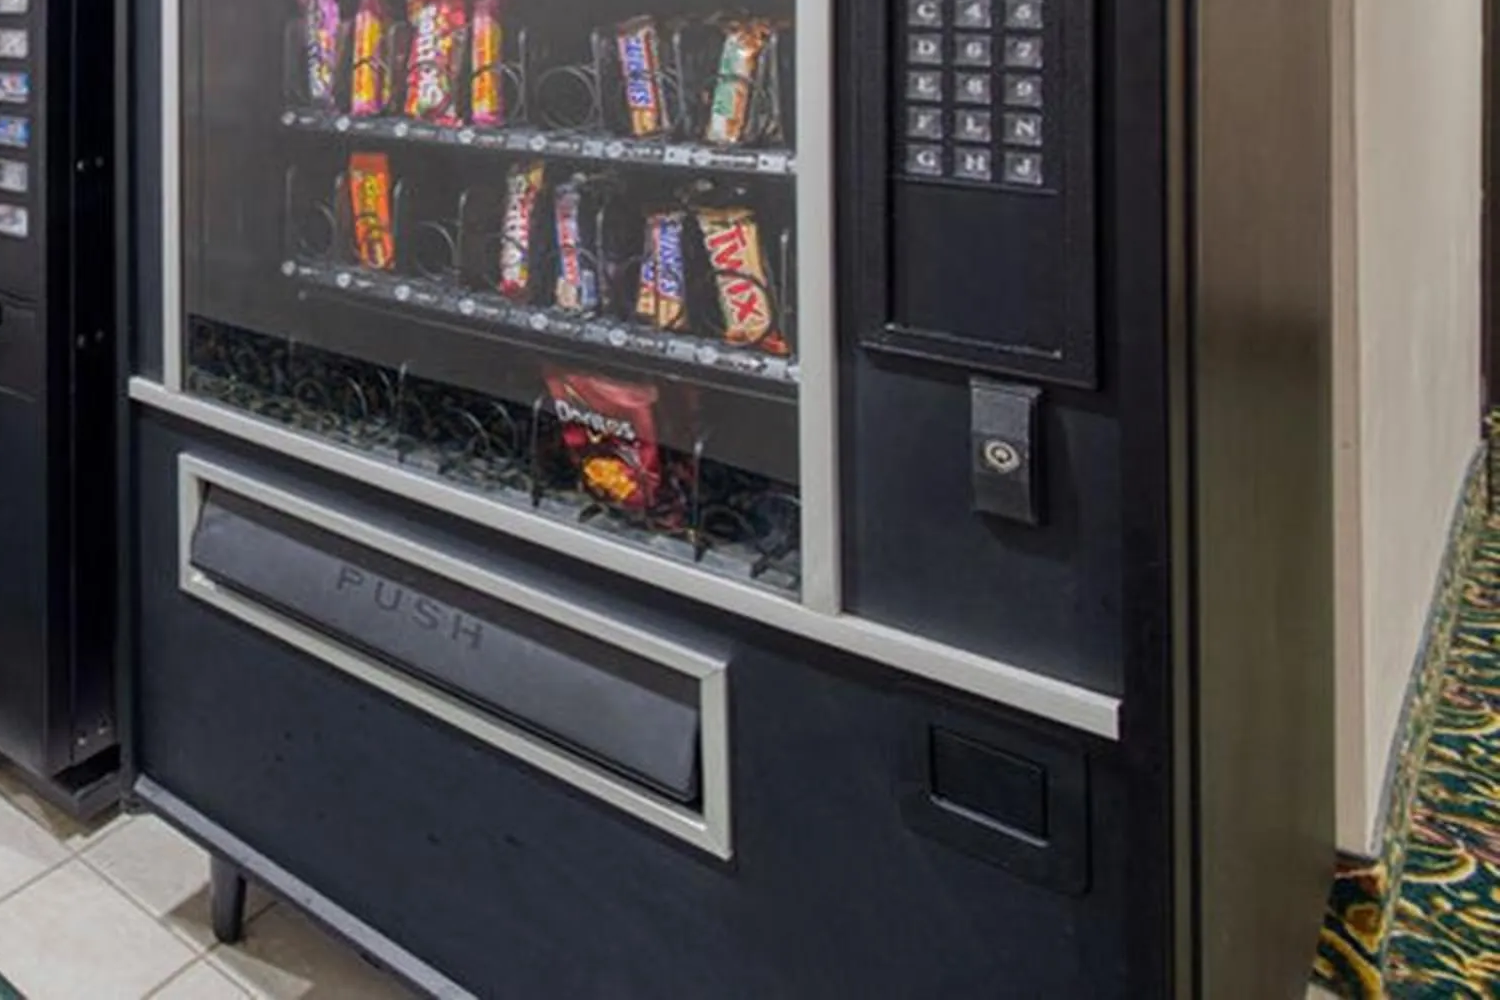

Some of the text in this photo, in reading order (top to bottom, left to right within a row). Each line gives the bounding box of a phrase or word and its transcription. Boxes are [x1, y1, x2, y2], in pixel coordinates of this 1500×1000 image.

[917, 2, 936, 19] C
[964, 2, 981, 19] 4
[918, 40, 936, 55] D
[918, 77, 935, 92] E
[966, 116, 983, 133] L
[916, 150, 935, 167] G
[965, 154, 986, 171] H
[1015, 159, 1030, 175] J
[335, 566, 484, 650] PUSH
